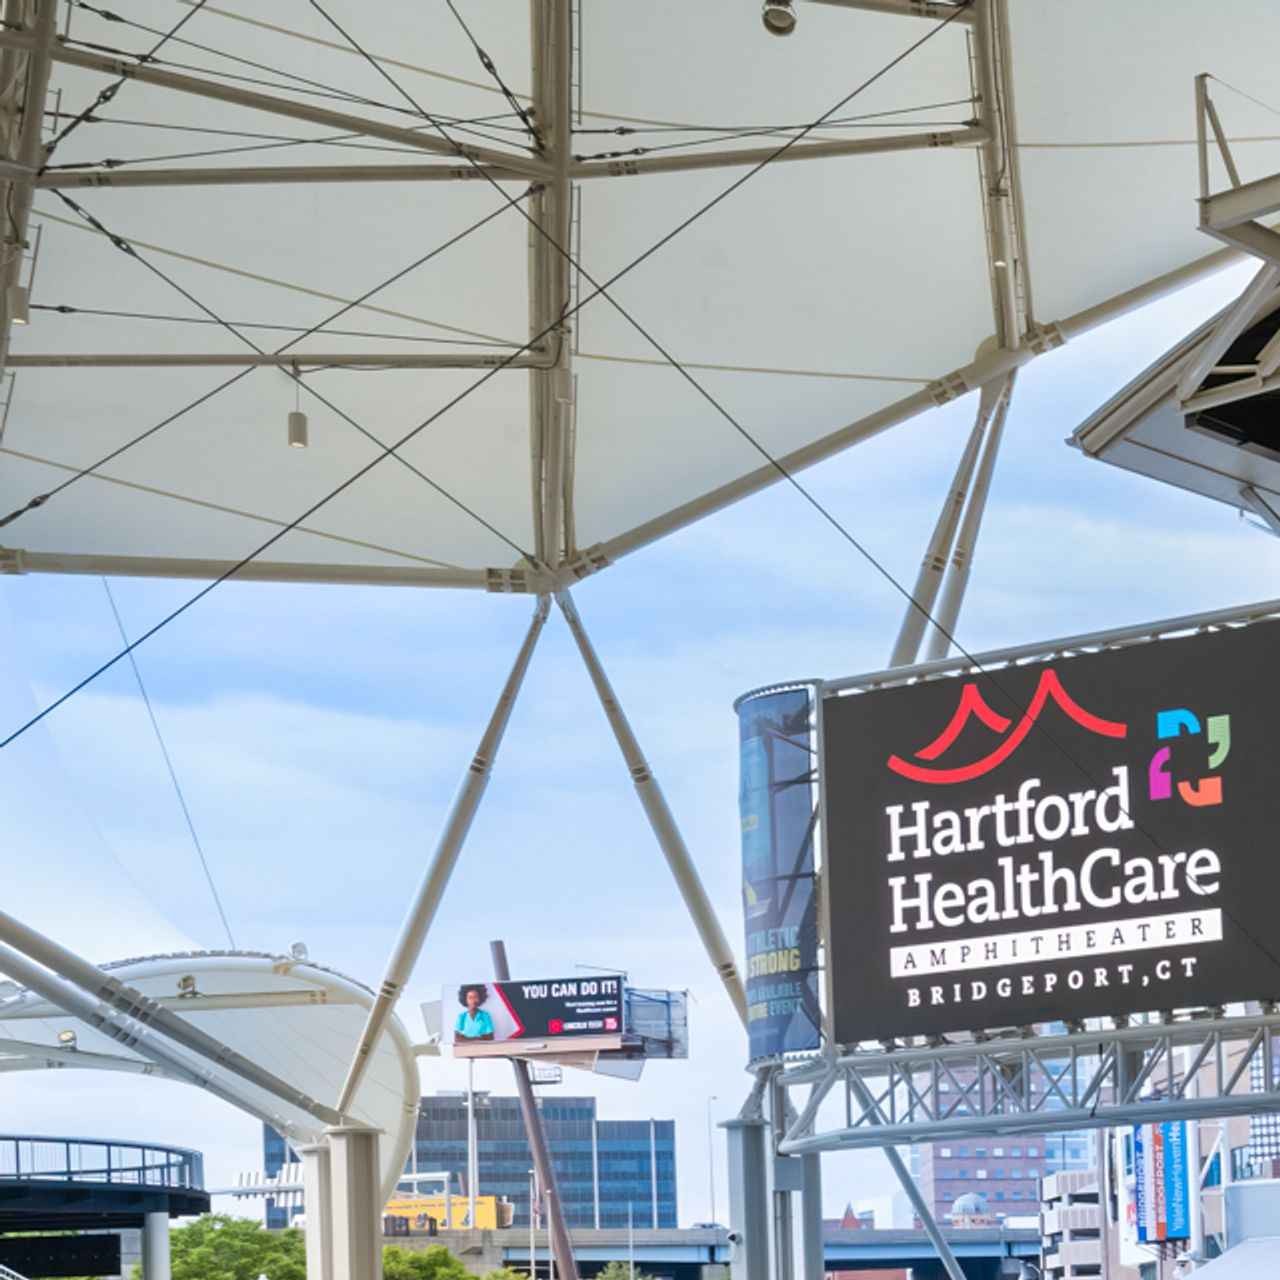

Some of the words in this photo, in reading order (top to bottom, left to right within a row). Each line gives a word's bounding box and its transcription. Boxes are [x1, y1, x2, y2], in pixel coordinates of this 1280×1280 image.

[884, 765, 1135, 863] Hartford
[887, 847, 1222, 935] HealthCare
[902, 917, 1207, 971] AMPHITHEATER
[522, 984, 548, 999] YOU
[551, 982, 577, 997] CAN
[580, 981, 598, 996] DO
[601, 980, 618, 994] IT!
[1155, 1144, 1166, 1223] BRIDGEPORT
